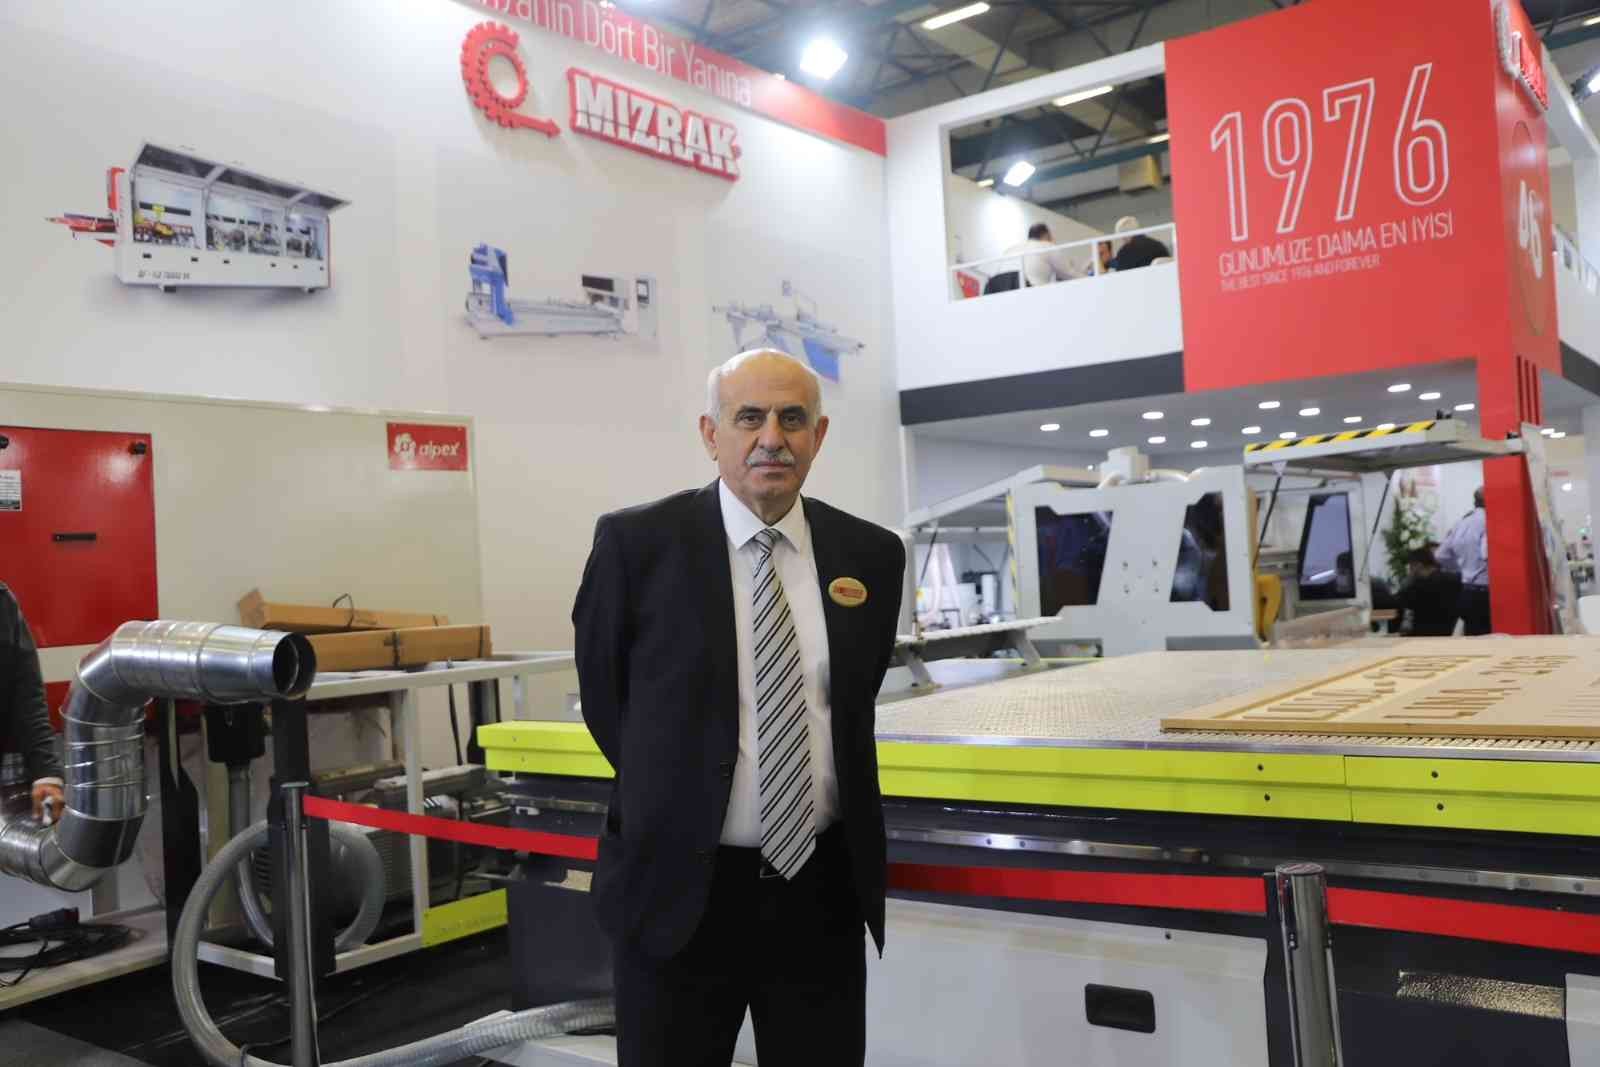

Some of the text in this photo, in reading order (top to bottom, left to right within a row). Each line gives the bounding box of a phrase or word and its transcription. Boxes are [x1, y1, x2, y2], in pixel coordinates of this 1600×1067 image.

[583, 2, 637, 63] Dört
[643, 24, 675, 76] Bir
[574, 75, 740, 176] MIZRAK
[1210, 62, 1450, 242] 1976
[1379, 219, 1408, 249] EN
